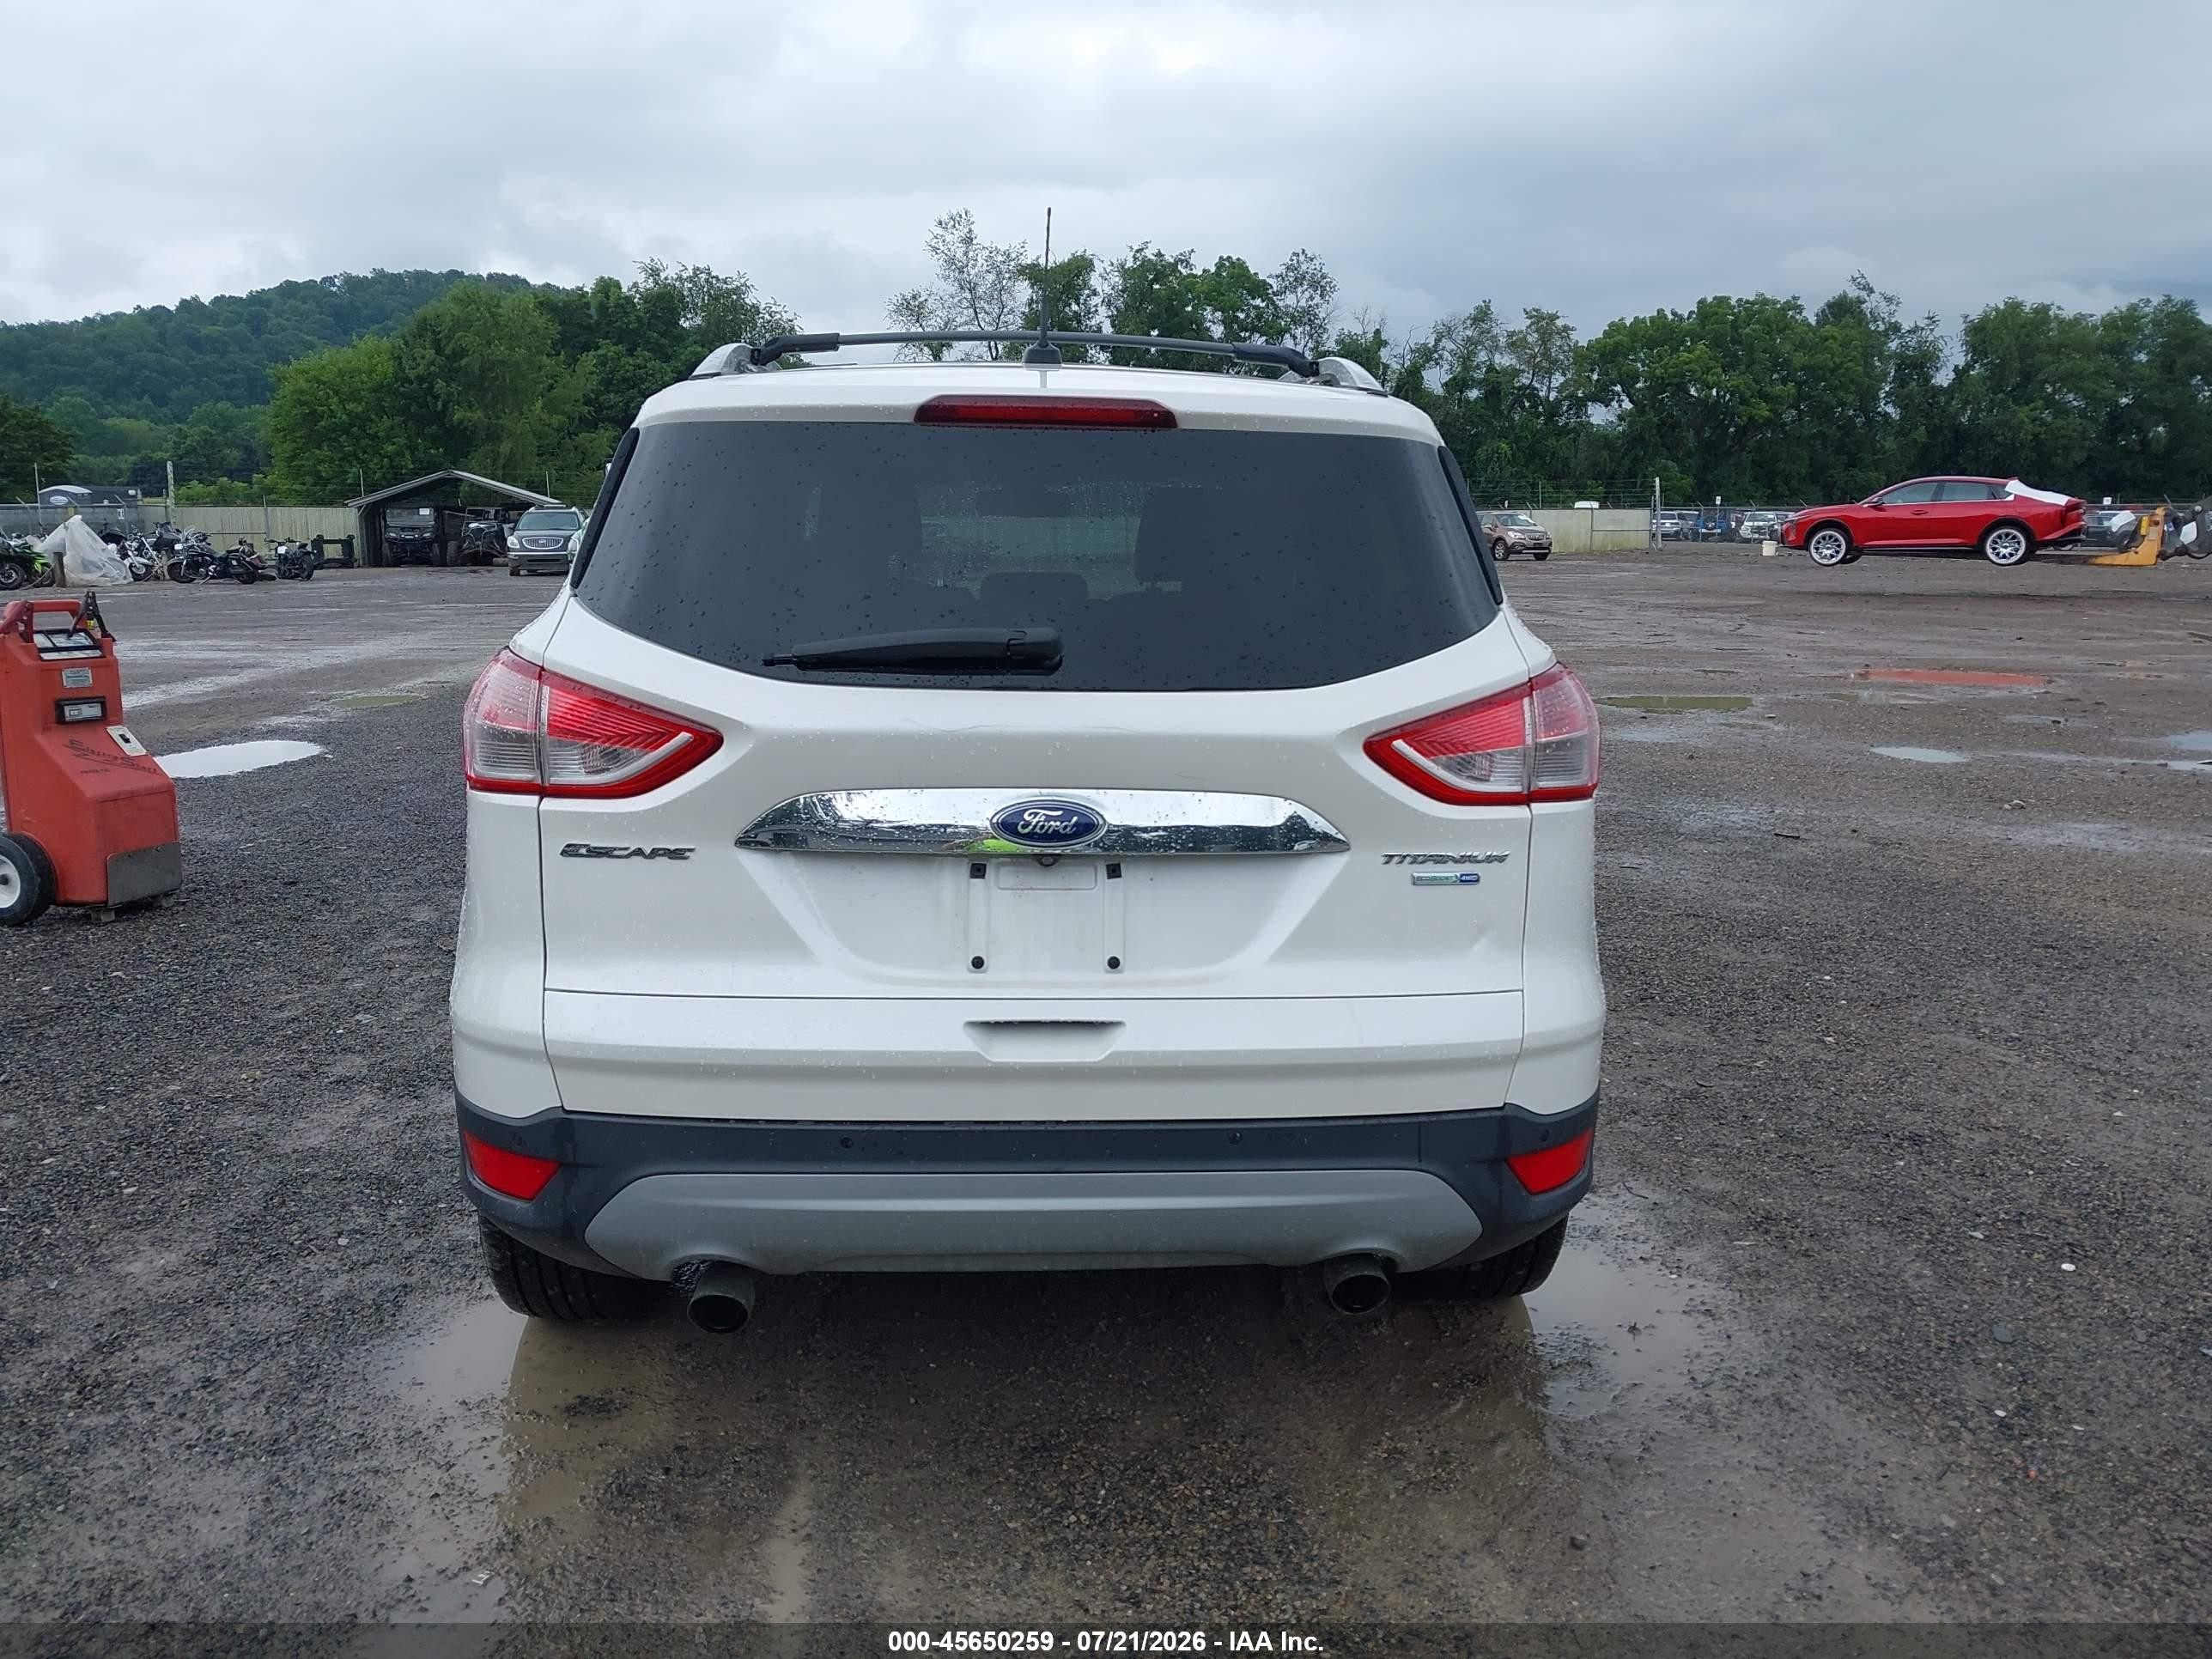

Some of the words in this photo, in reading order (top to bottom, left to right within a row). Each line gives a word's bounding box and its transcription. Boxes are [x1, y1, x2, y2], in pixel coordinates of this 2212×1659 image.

[1017, 809, 1079, 835] Ford
[559, 842, 696, 860] ESCAPE
[1382, 851, 1510, 865] TITANIUM
